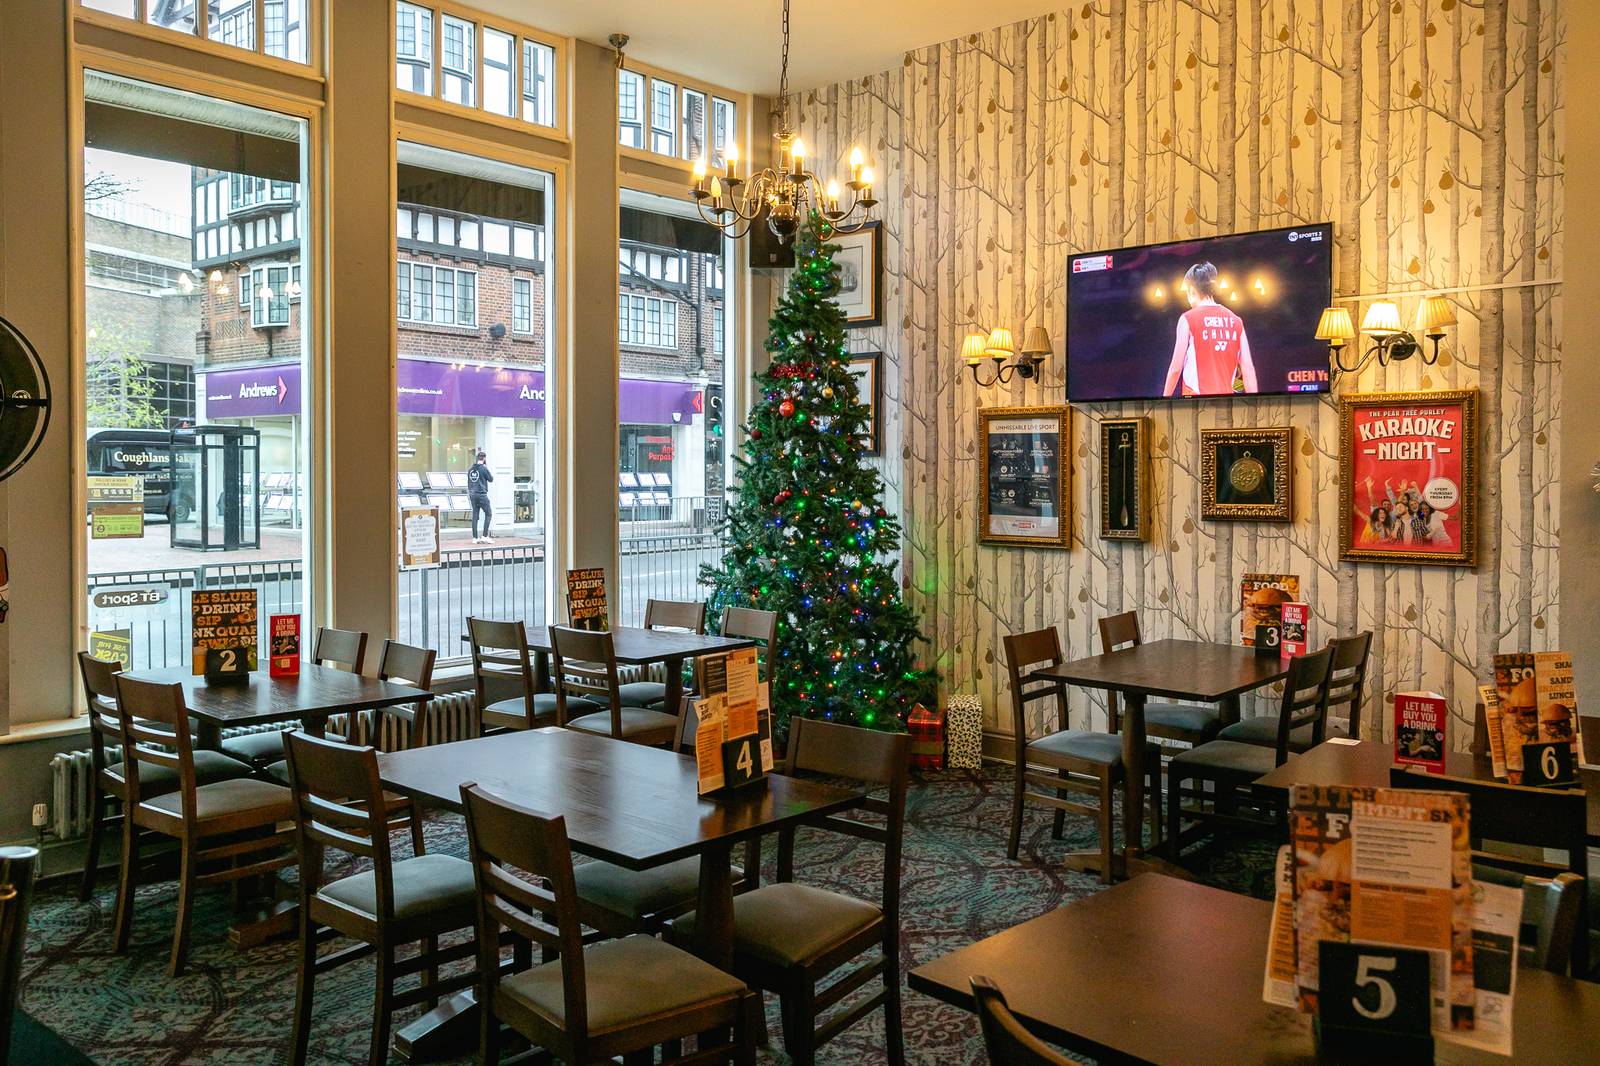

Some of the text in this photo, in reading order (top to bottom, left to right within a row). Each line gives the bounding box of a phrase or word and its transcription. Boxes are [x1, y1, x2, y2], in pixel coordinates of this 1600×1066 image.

[1202, 329, 1237, 341] CHINA
[1288, 371, 1315, 382] CHEN
[239, 382, 278, 399] Andrews
[1419, 408, 1446, 416] PURLEY
[1358, 417, 1456, 442] KARAOKE
[1378, 441, 1436, 461] NIGHT
[114, 451, 170, 465] Coughlans
[575, 579, 603, 590] DRINK
[1253, 581, 1289, 591] FOOD
[572, 590, 588, 599] SIP
[202, 602, 252, 615] DRINK
[196, 615, 221, 626] SIP
[193, 627, 215, 638] NK
[1266, 627, 1279, 646] 3
[220, 650, 237, 672] 2
[1405, 701, 1435, 711] LET ME
[1403, 710, 1437, 722] BUY YOU
[1403, 720, 1437, 731] A DRINK
[736, 740, 753, 779] 4
[1541, 746, 1559, 780] 6
[1352, 954, 1397, 1020] 5
